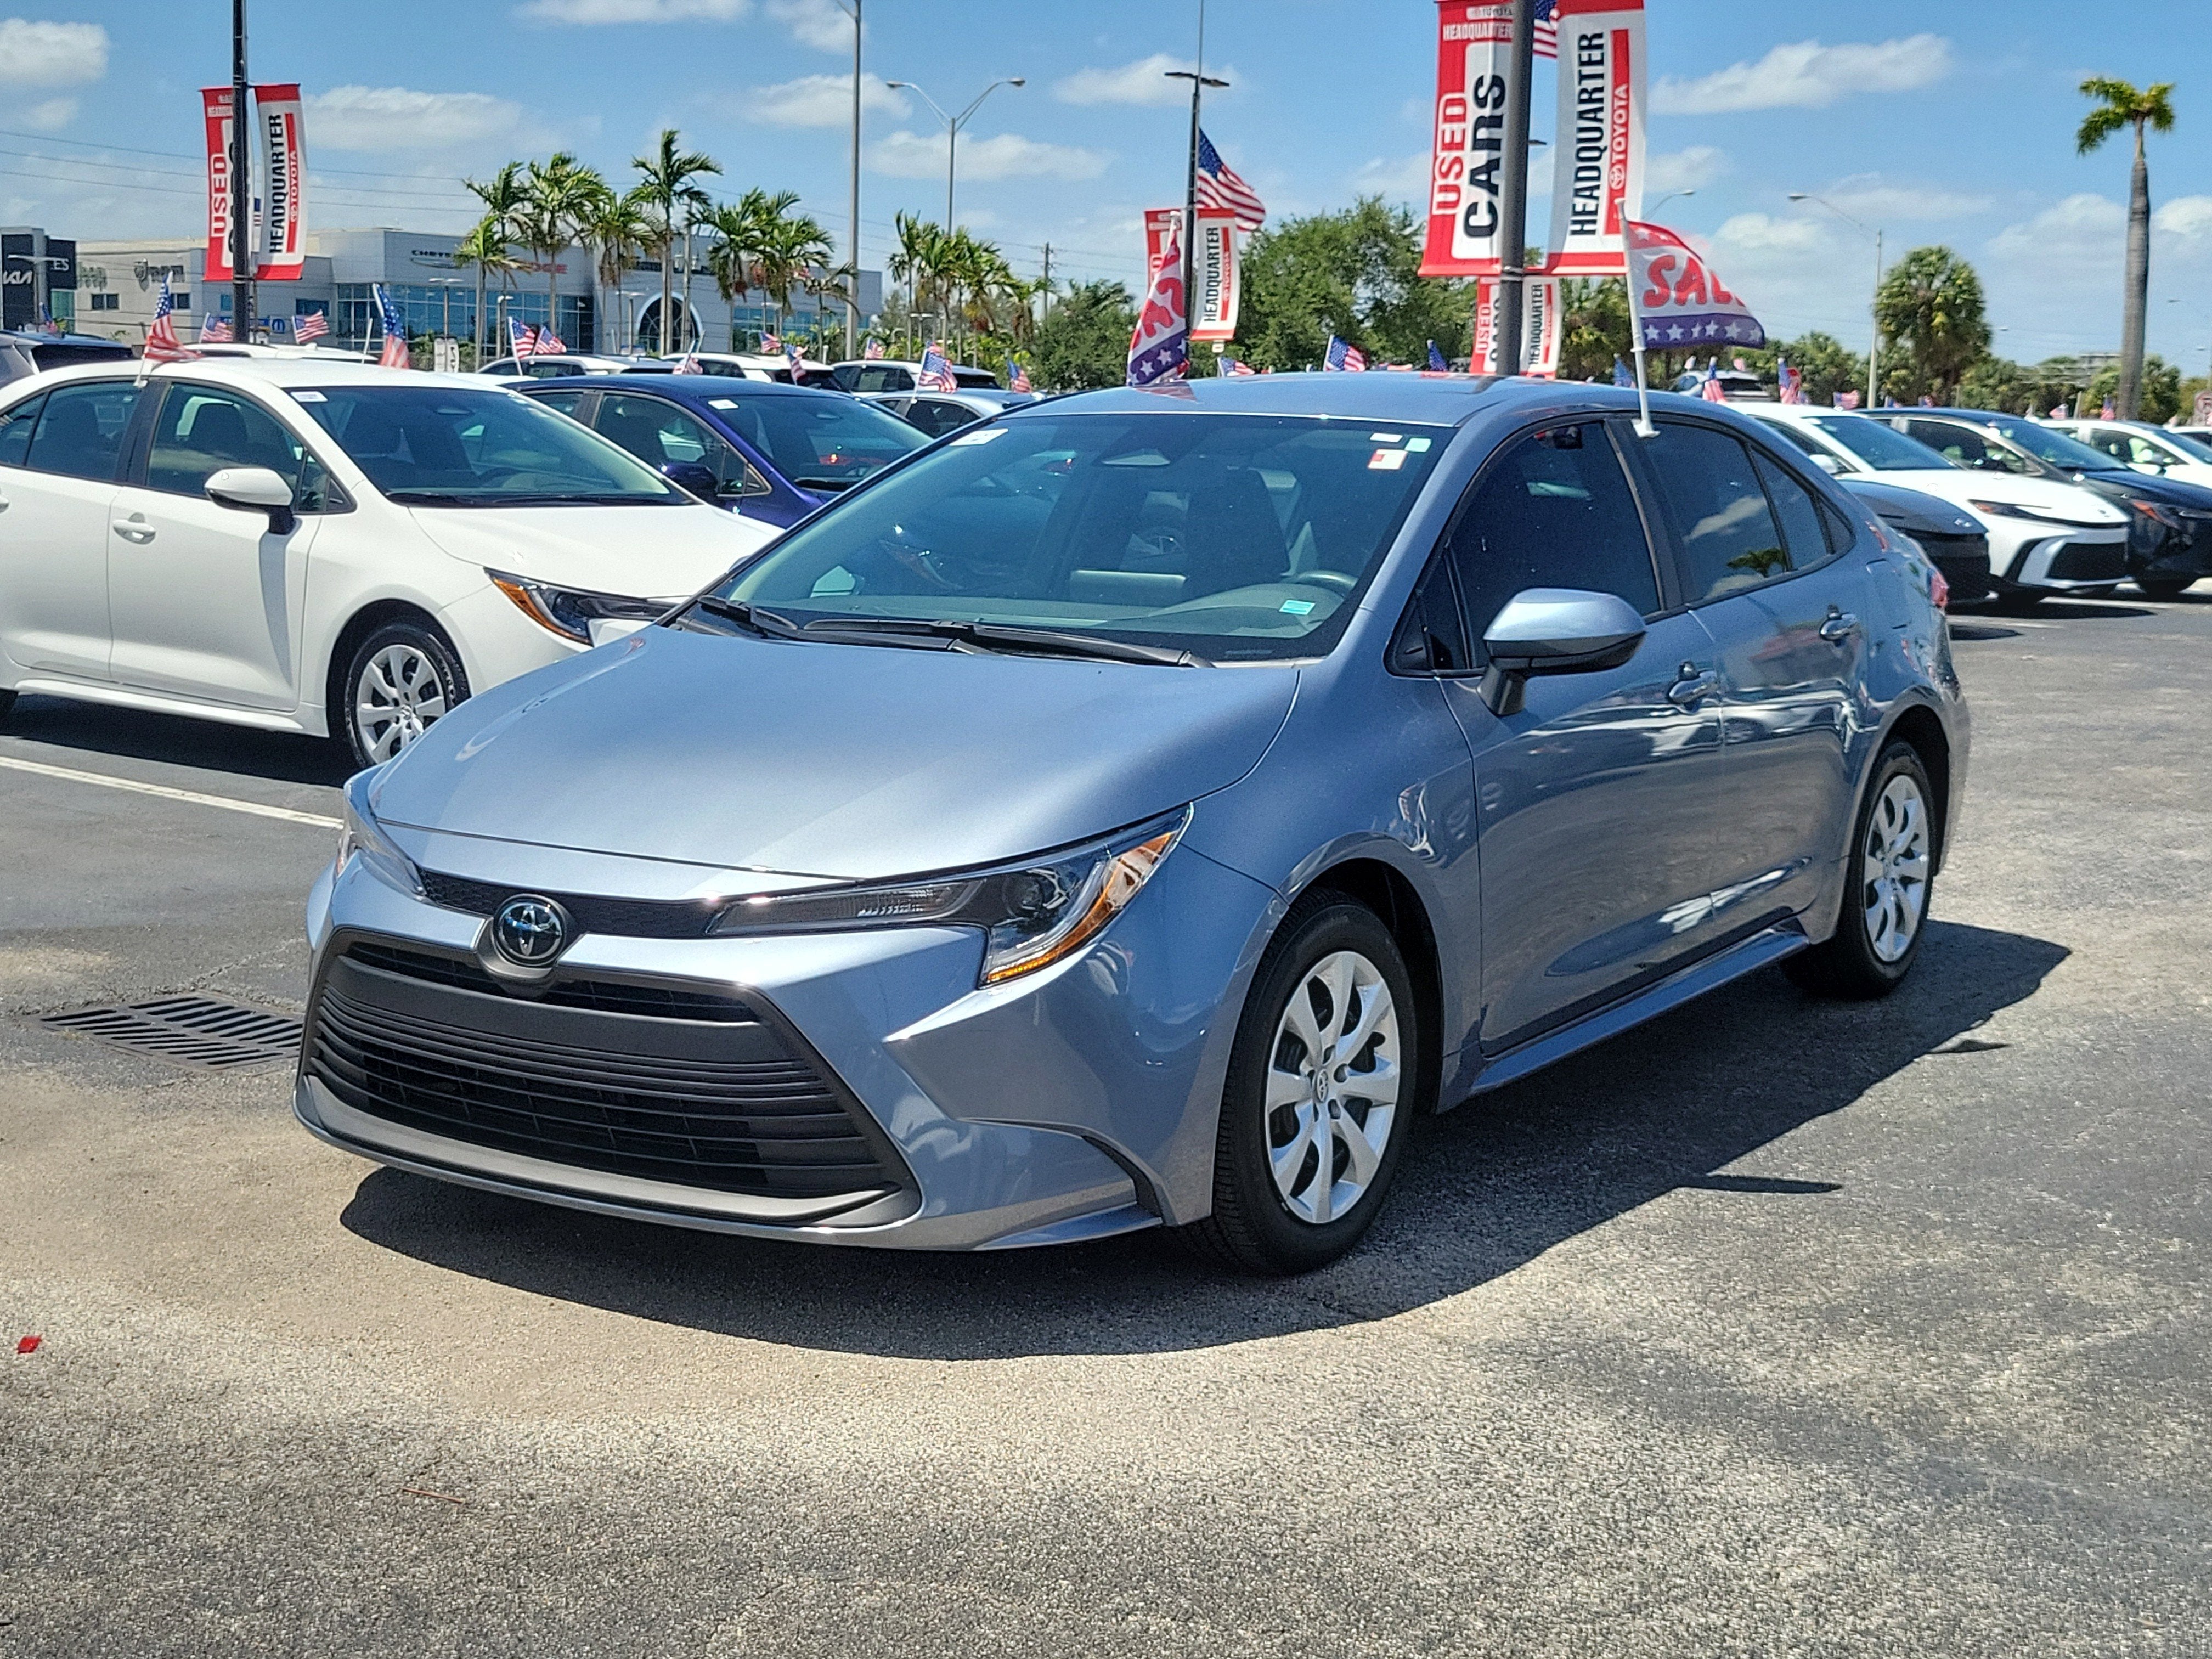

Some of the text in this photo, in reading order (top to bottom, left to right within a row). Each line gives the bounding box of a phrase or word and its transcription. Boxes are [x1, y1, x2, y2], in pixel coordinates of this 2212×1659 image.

[1435, 97, 1466, 211] USED
[1464, 75, 1505, 237] CARS
[1570, 32, 1607, 236] HEADQUARTER
[1612, 84, 1628, 163] TOYOTA
[212, 155, 228, 235] USED
[269, 114, 289, 253] HEADQUARTER
[290, 150, 298, 204] TOYOTA
[3, 270, 32, 284] KIA
[1204, 227, 1221, 322] HEADQUARTER
[1643, 255, 1746, 308] SAL
[1478, 306, 1491, 351] USED
[1528, 284, 1543, 365] HEADQUARTER
